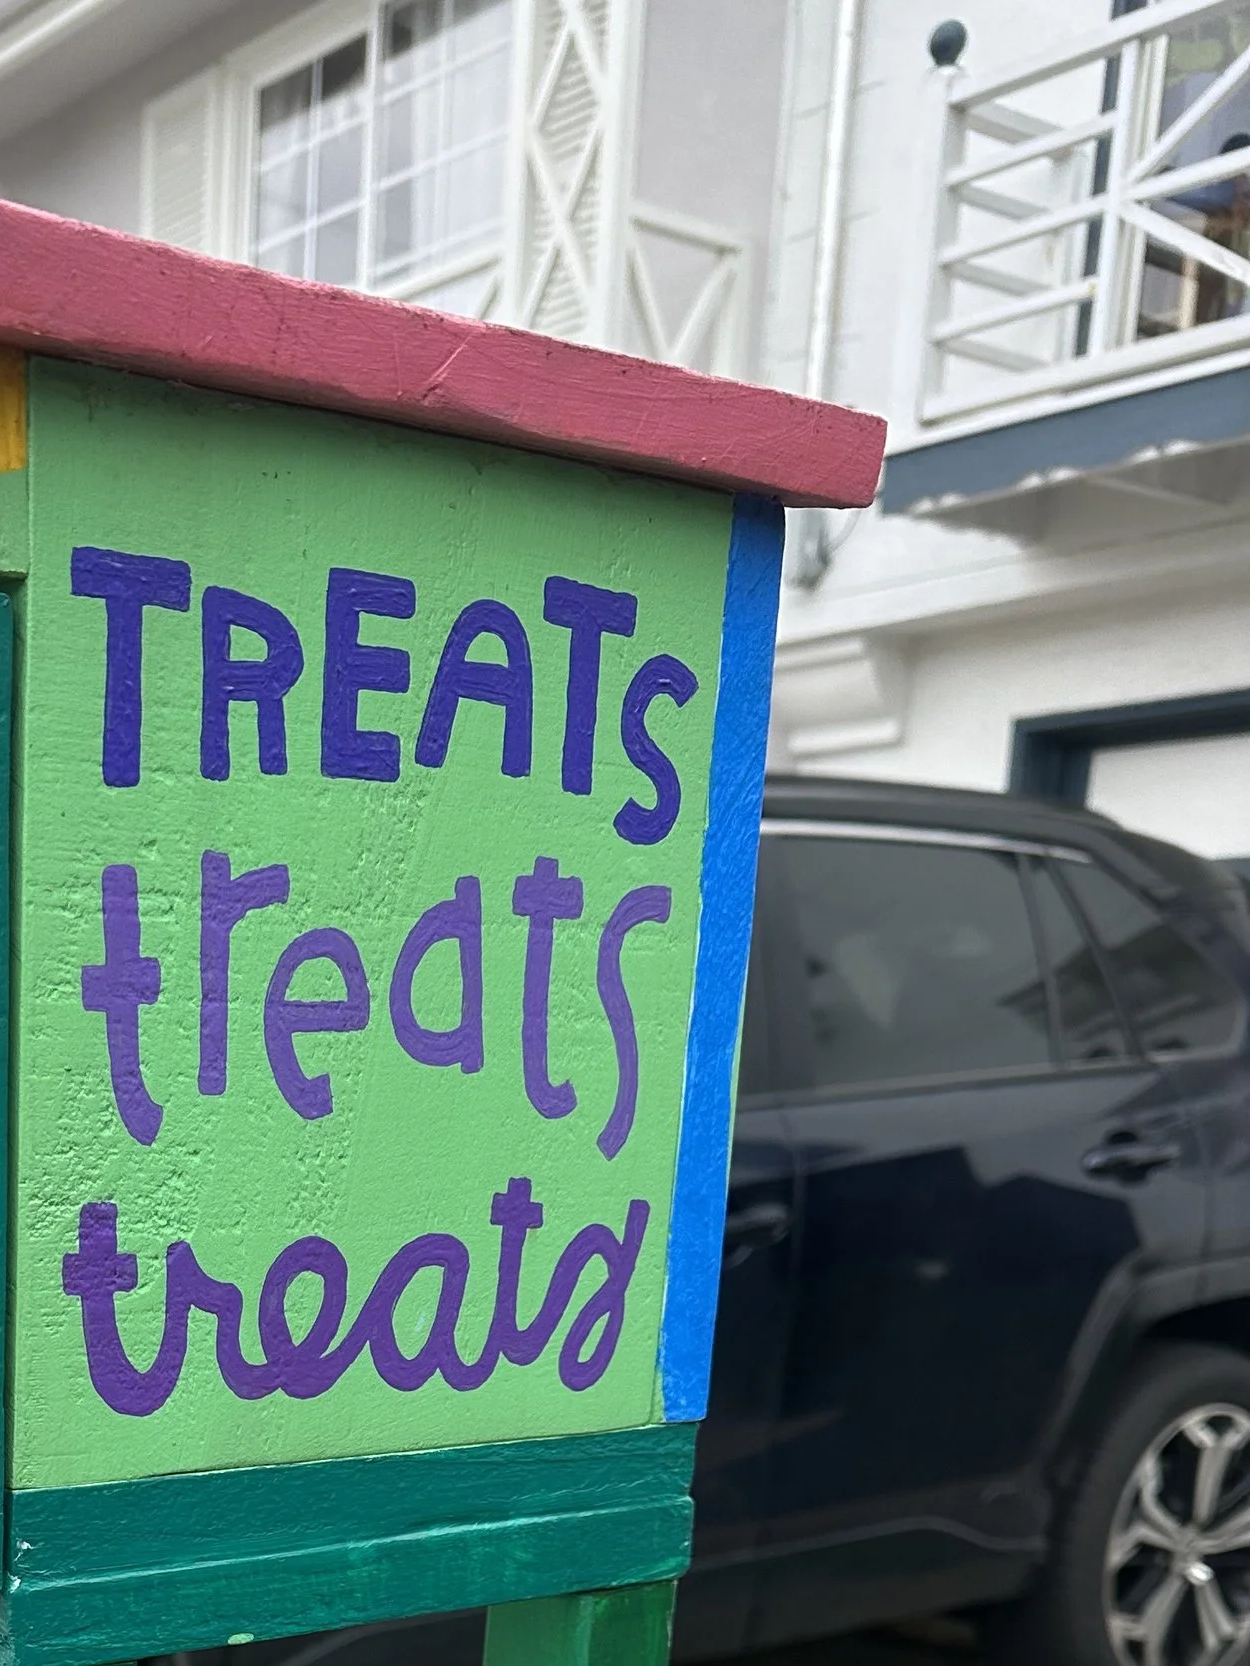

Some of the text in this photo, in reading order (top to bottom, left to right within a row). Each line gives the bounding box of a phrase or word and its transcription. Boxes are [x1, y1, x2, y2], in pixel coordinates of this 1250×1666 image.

[70, 545, 699, 846] TREATS
[80, 849, 673, 1161] treats
[61, 1176, 651, 1417] treats
